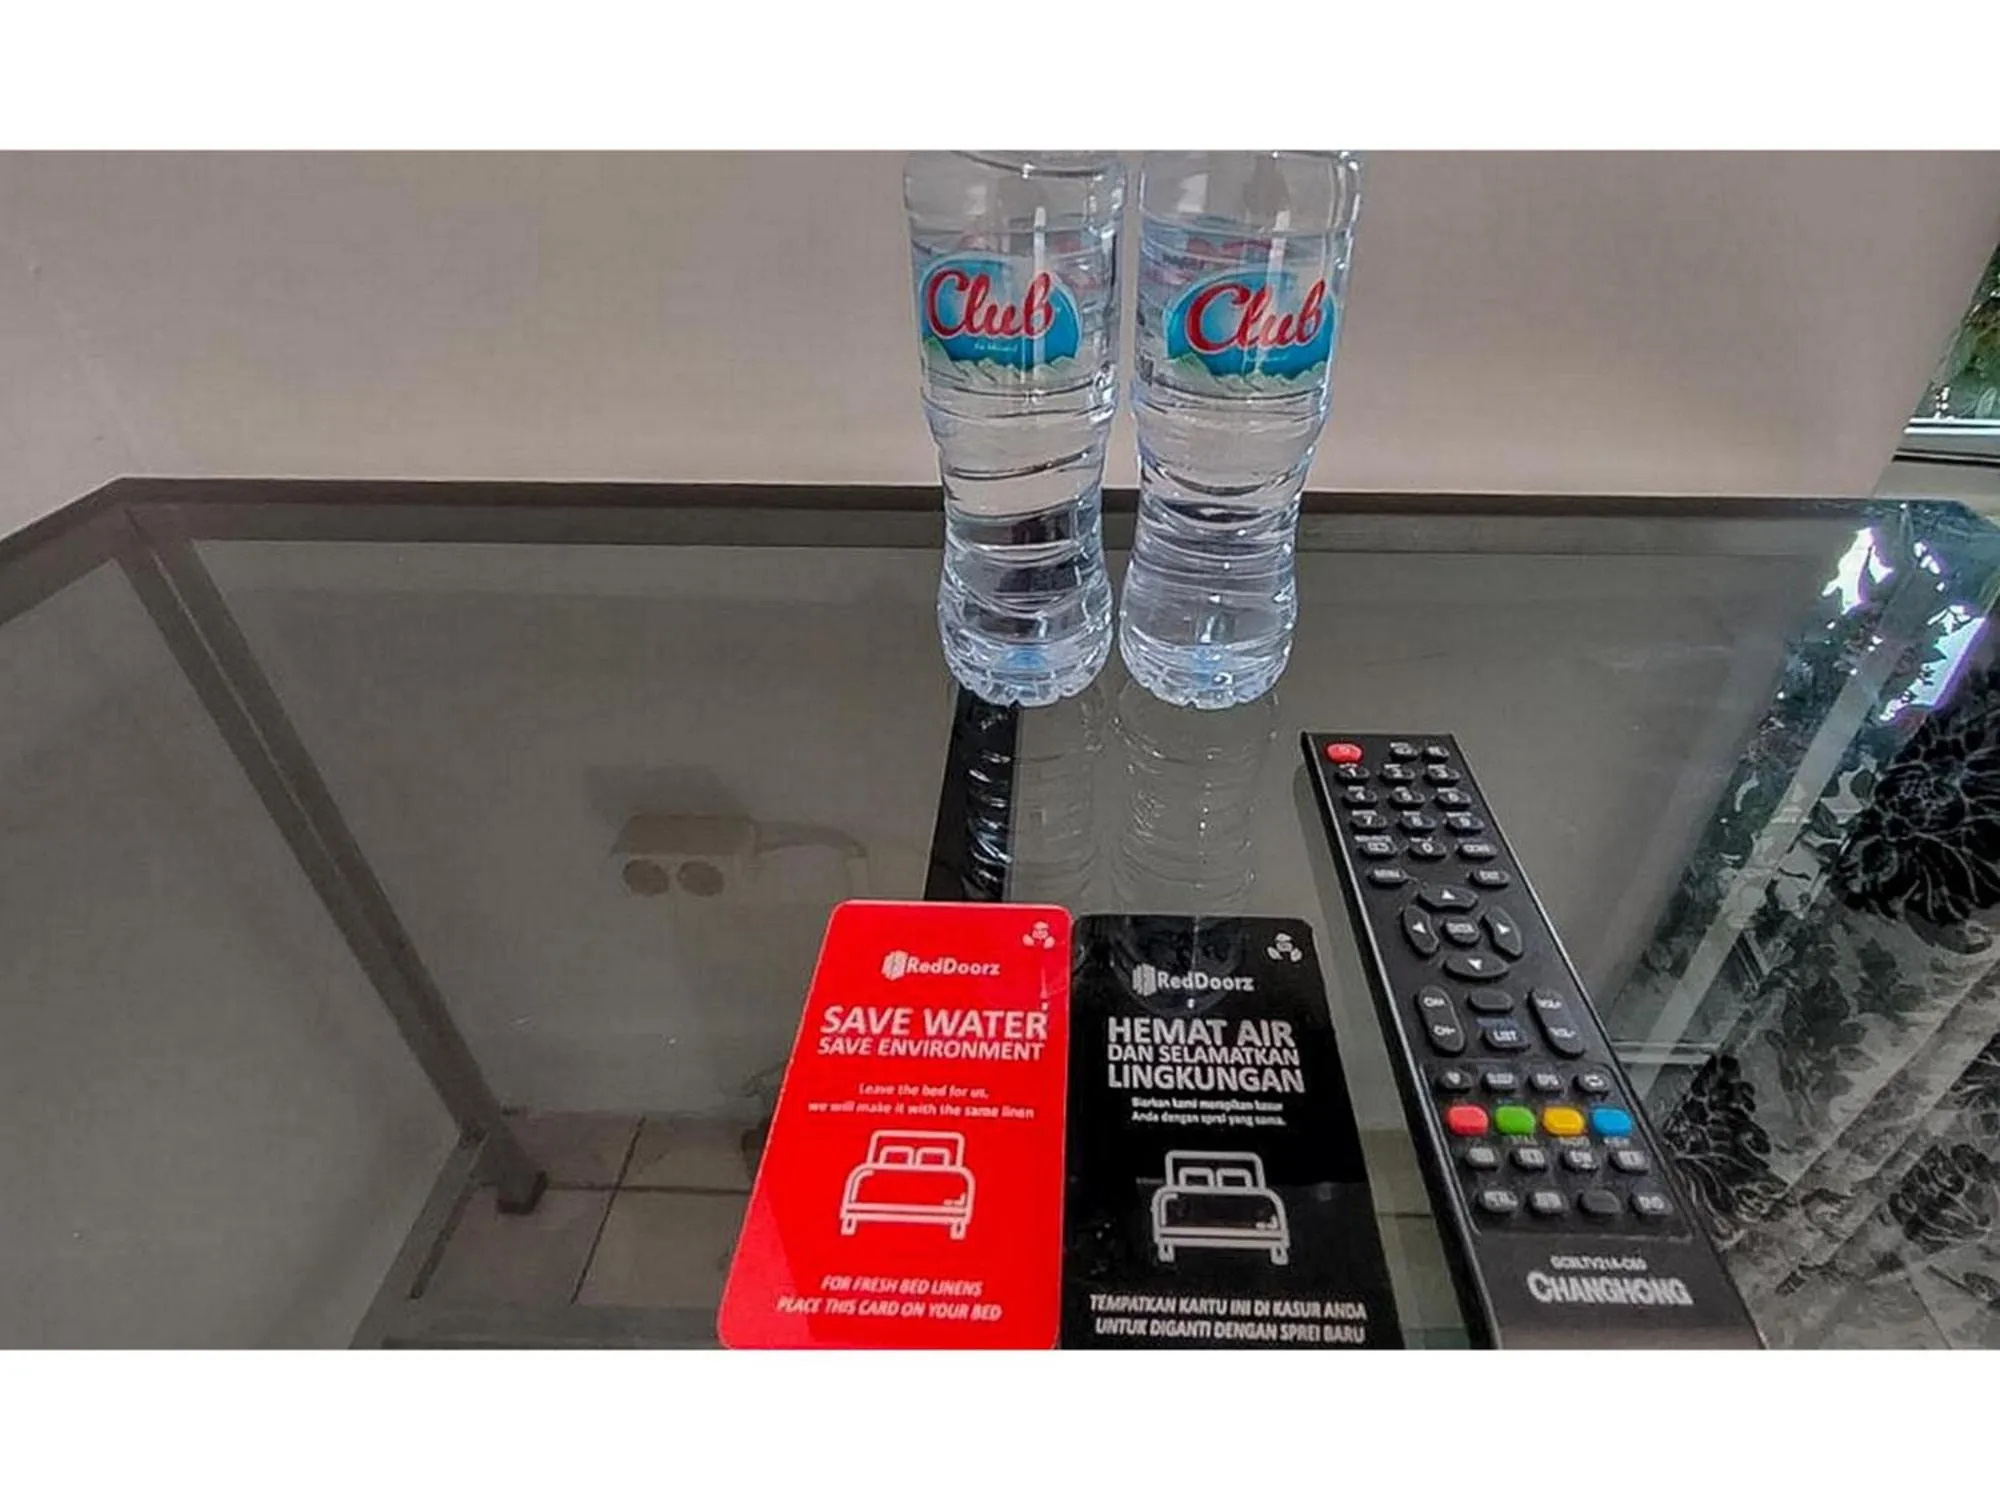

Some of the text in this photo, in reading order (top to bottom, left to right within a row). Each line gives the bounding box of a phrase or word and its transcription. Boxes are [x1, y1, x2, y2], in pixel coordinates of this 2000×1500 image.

[926, 265, 1055, 339] Club
[1184, 276, 1327, 352] Club
[905, 956, 1001, 977] RedDoorz
[1157, 971, 1255, 992] RedDoorz
[820, 1004, 1048, 1040] SAVE WATER
[1108, 1016, 1296, 1048] HEMAT AIR
[817, 1036, 1045, 1061] SAVE ENVIRONMENT
[1108, 1043, 1300, 1067] DAN SELAMATKAN
[859, 1082, 895, 1097] Leave
[898, 1082, 920, 1097] the
[922, 1083, 947, 1098] bed
[949, 1084, 968, 1099] for
[1108, 1063, 1305, 1094] LINGKUNGAN
[808, 1099, 1035, 1120] we will make it with the same linen
[1131, 1110, 1159, 1123] Anda
[1161, 1111, 1199, 1126] dengan
[1228, 1114, 1254, 1127] yang
[821, 1274, 983, 1297] FOR FRESH BED LINENS
[1527, 1270, 1694, 1305] CHANGHONG
[776, 1295, 1004, 1322] PLACE THIS CARD ON YOUR BED
[1089, 1293, 1368, 1321] TEMPATKAN KARTU INI DI KASUR ANDA
[1095, 1316, 1365, 1345] UNTUK DIGANTI DENGAN SPREI BARU
